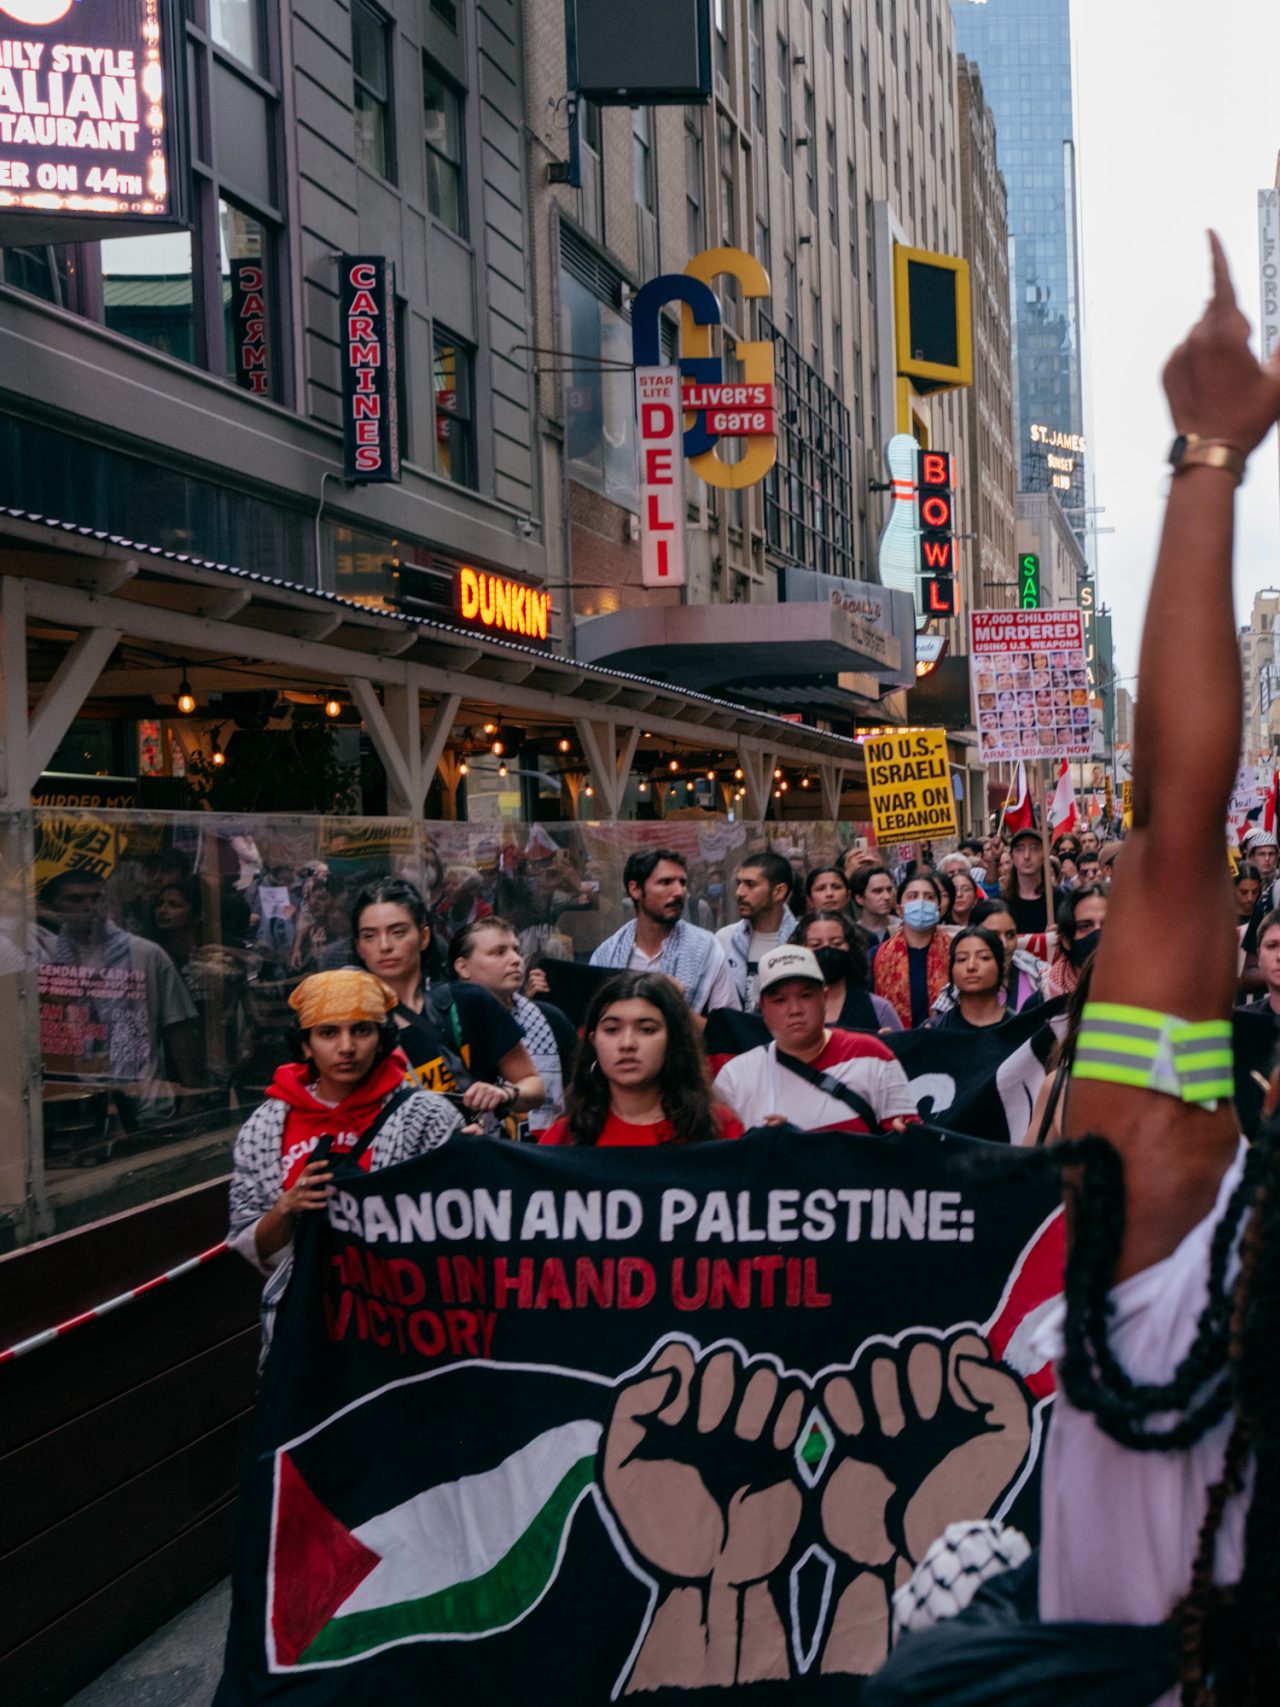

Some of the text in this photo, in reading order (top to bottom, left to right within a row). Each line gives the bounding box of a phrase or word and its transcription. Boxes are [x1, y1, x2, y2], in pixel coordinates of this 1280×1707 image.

[52, 45, 136, 77] STYLE
[36, 163, 78, 191] ON
[85, 166, 143, 195] 44TH
[1258, 191, 1279, 316] MILFORD
[348, 263, 382, 472] CARMINES
[640, 375, 674, 387] STAR
[643, 387, 671, 399] LITE
[641, 403, 675, 577] DELI
[922, 454, 949, 609] BOWL
[461, 566, 553, 640] DUNKIN'
[974, 612, 1078, 625] 17,000 CHILDREN
[974, 624, 1079, 641] MURDERED
[975, 640, 1080, 652] USING U.S. WEAPONS
[867, 737, 943, 763] NO U.S.-
[982, 745, 1090, 760] ARMS EMBARGO NOW
[870, 758, 946, 786] ISRAELI
[31, 795, 100, 808] MURDER
[873, 786, 949, 814] WAR ON
[877, 807, 951, 832] LEBANON
[520, 1188, 643, 1242] AND
[660, 1187, 974, 1244] PALESTINE:
[436, 1255, 486, 1305] IN
[494, 1256, 656, 1311] HAND
[671, 1255, 832, 1311] UNTIL
[324, 1290, 498, 1360] VICTORY
